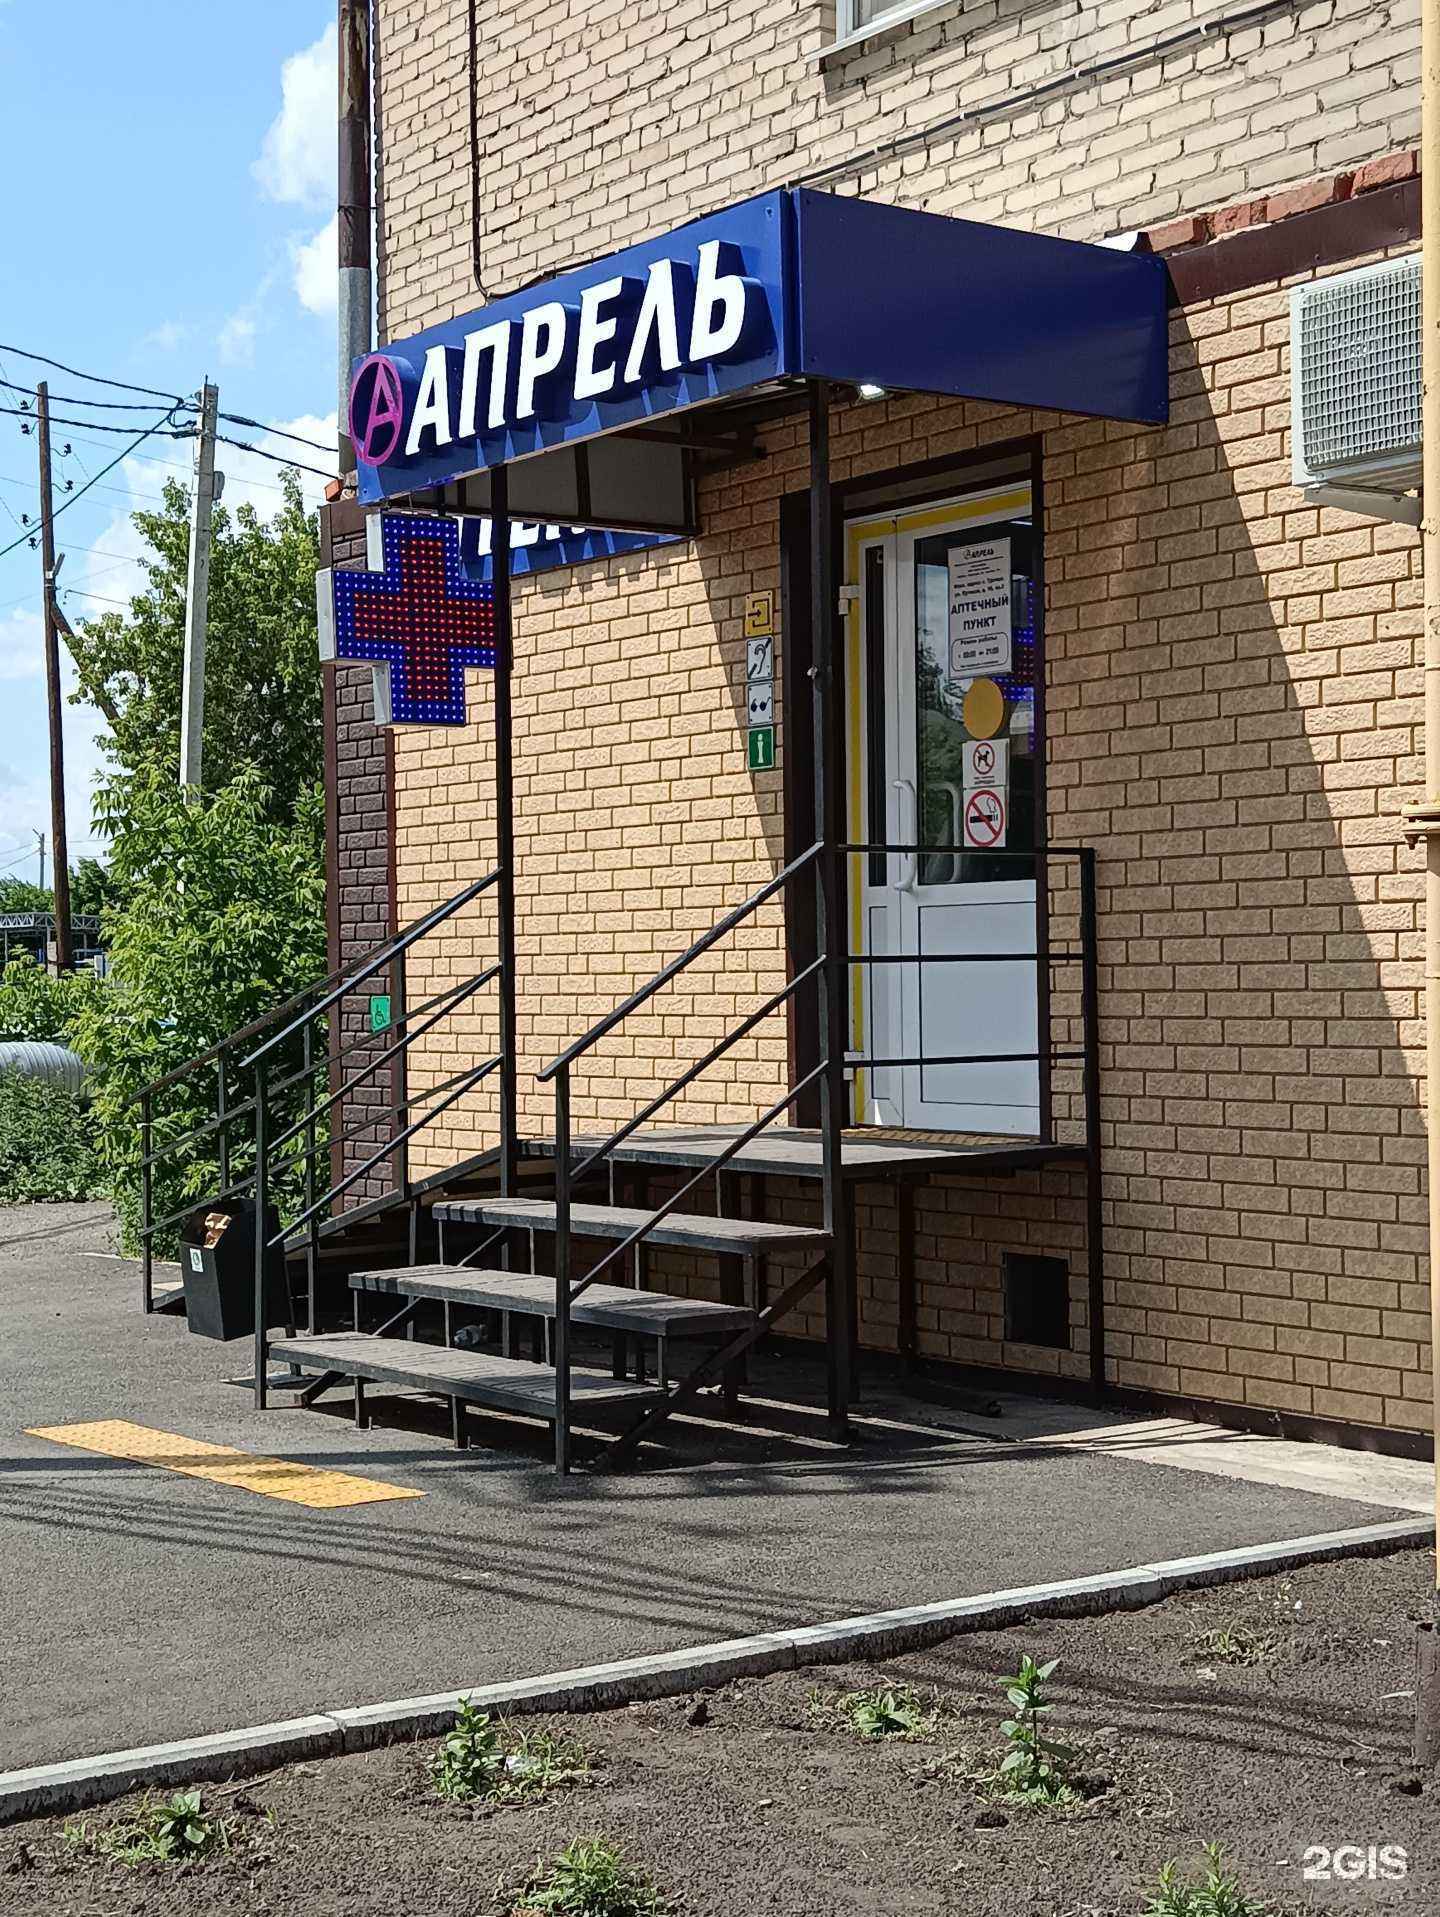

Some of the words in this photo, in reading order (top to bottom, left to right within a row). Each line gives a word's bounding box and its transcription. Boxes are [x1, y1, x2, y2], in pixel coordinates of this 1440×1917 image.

[404, 239, 747, 456] АПРЕЛЬ
[950, 593, 1009, 615] АПТЕЧНЫЙ
[963, 615, 997, 631] ПУНКТ
